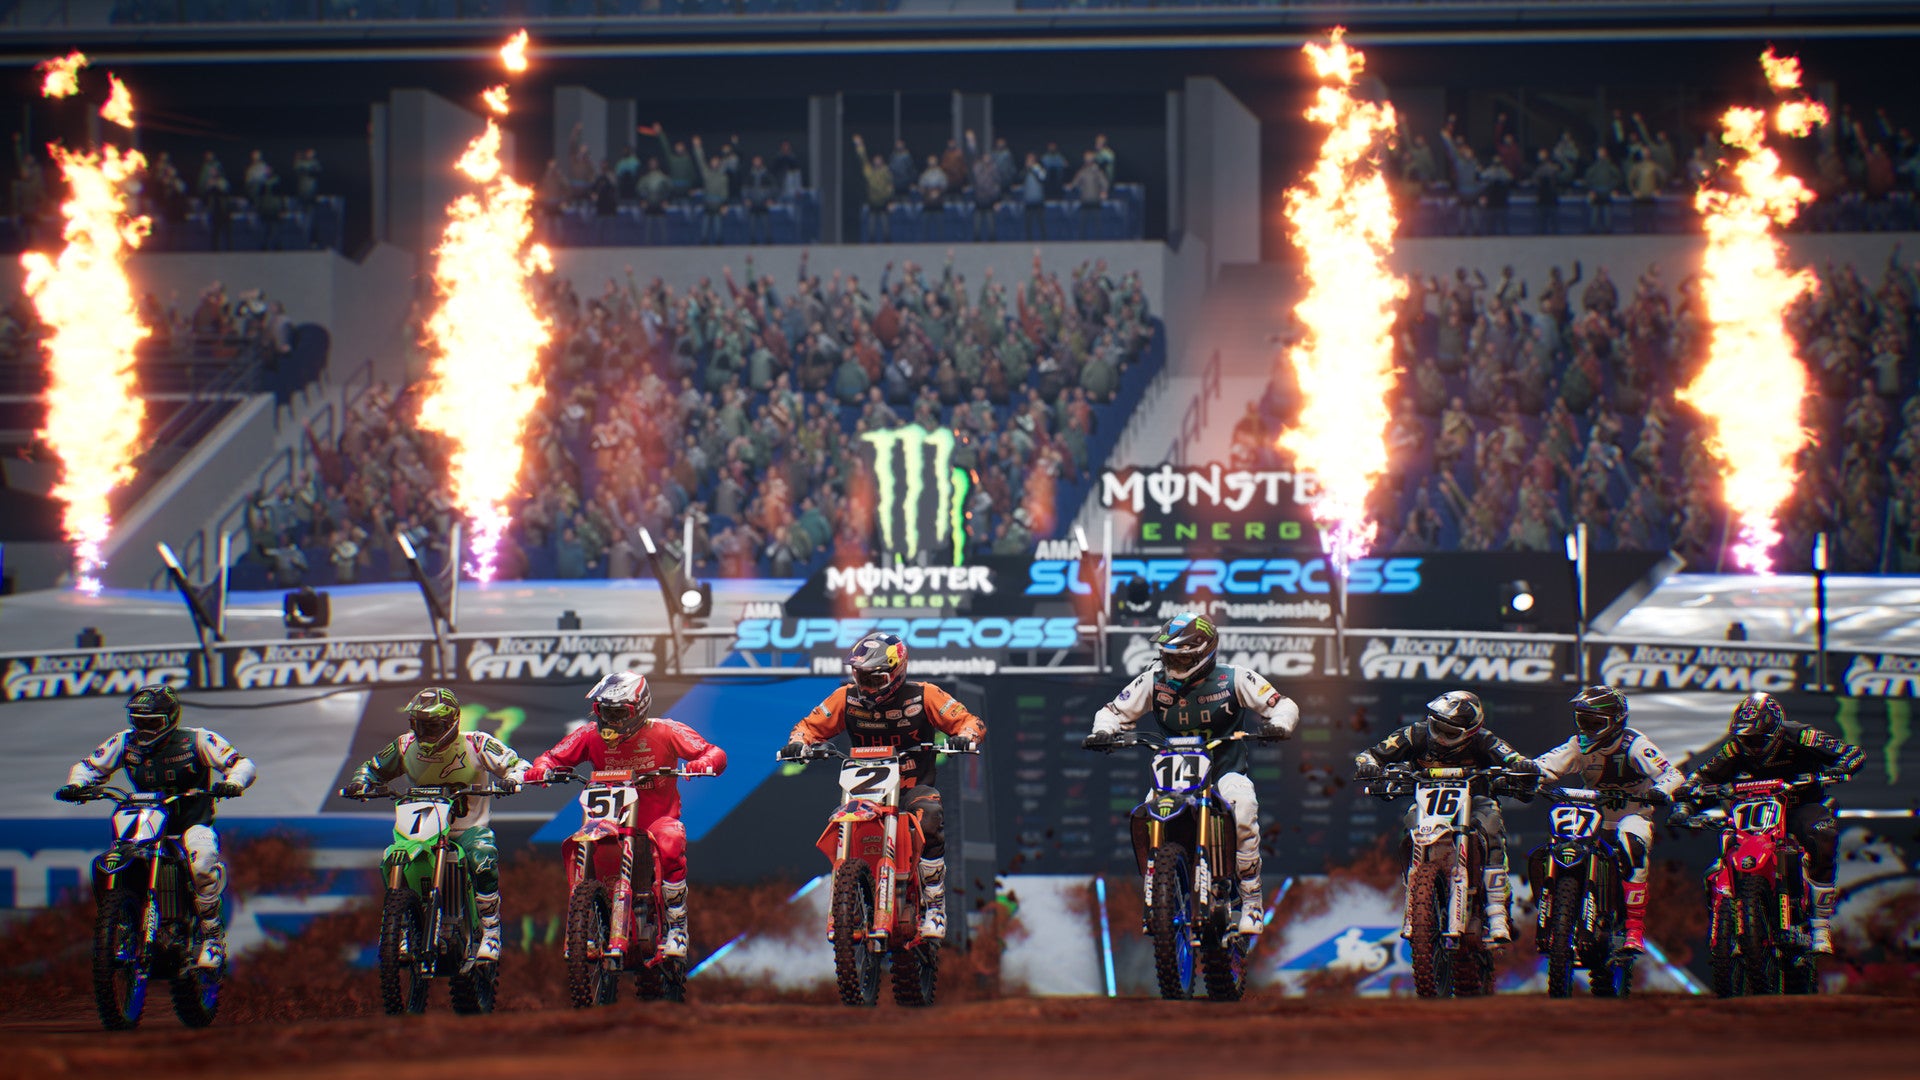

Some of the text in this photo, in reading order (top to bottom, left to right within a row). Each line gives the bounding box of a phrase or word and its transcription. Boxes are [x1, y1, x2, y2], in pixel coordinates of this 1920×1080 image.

[1101, 464, 1323, 513] MONSTE
[1035, 540, 1082, 560] AMA
[825, 562, 995, 594] MONSTER
[743, 603, 782, 619] AMA
[855, 594, 962, 609] ENERGY
[496, 635, 657, 653] ROCKY MOUNTAIN
[734, 617, 1080, 649] SUPERCROSS
[263, 642, 423, 662] ROCKY MOUNTAIN
[1391, 637, 1555, 658] ROCKY MOUNTAIN
[1633, 645, 1799, 668] ROCKY MOUNTAIN
[33, 652, 190, 673] ROCKY MOUNTAIN
[812, 657, 844, 676] FIM
[1205, 689, 1231, 702] YAMAHA
[850, 766, 892, 796] 2
[1156, 755, 1200, 790] 14
[587, 789, 625, 819] 51
[1426, 789, 1461, 816] 16
[410, 806, 435, 835] 1
[1555, 807, 1596, 837] 27
[1199, 857, 1209, 906] DUNLOP
[1586, 891, 1596, 933] DUNLOP
